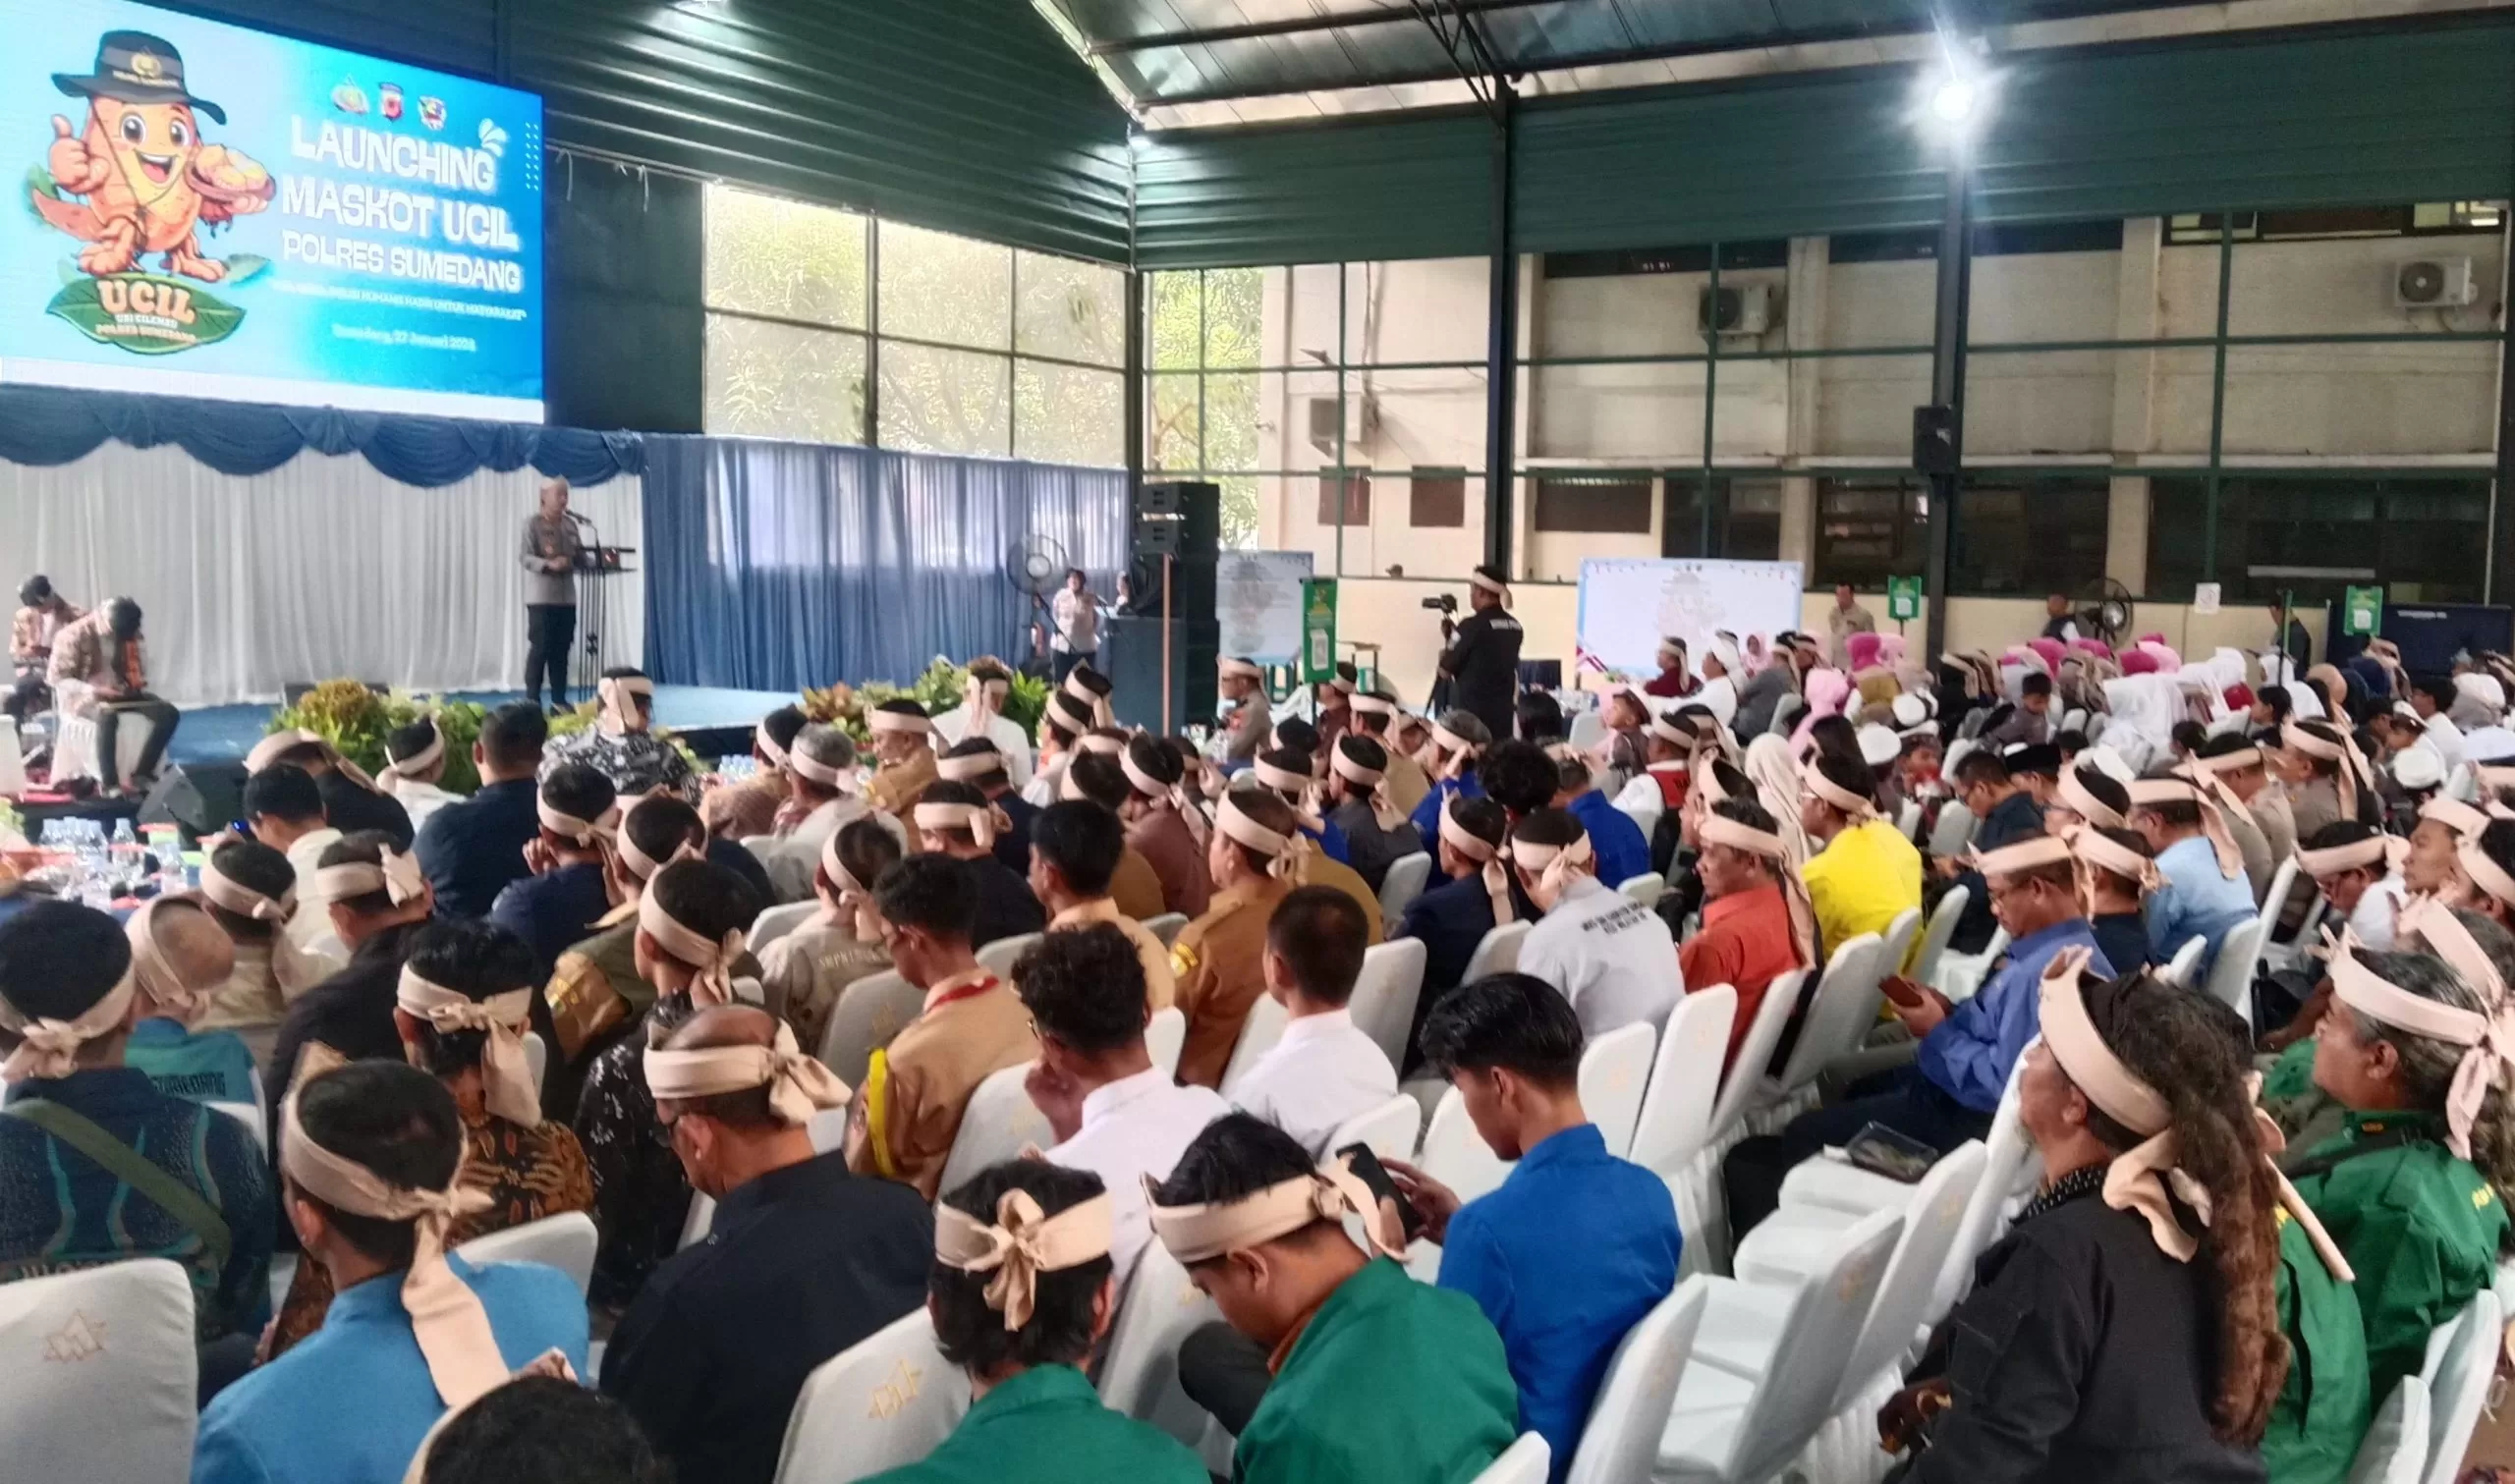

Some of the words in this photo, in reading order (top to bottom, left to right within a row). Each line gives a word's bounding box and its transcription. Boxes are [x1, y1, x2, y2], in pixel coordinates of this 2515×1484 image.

[290, 113, 496, 194] LAUNCHING
[281, 173, 435, 238] MASKOT
[442, 198, 520, 252] UCIL
[282, 228, 385, 273] POLRES
[390, 246, 523, 294] SUMEDANG
[96, 279, 196, 325] UCIL
